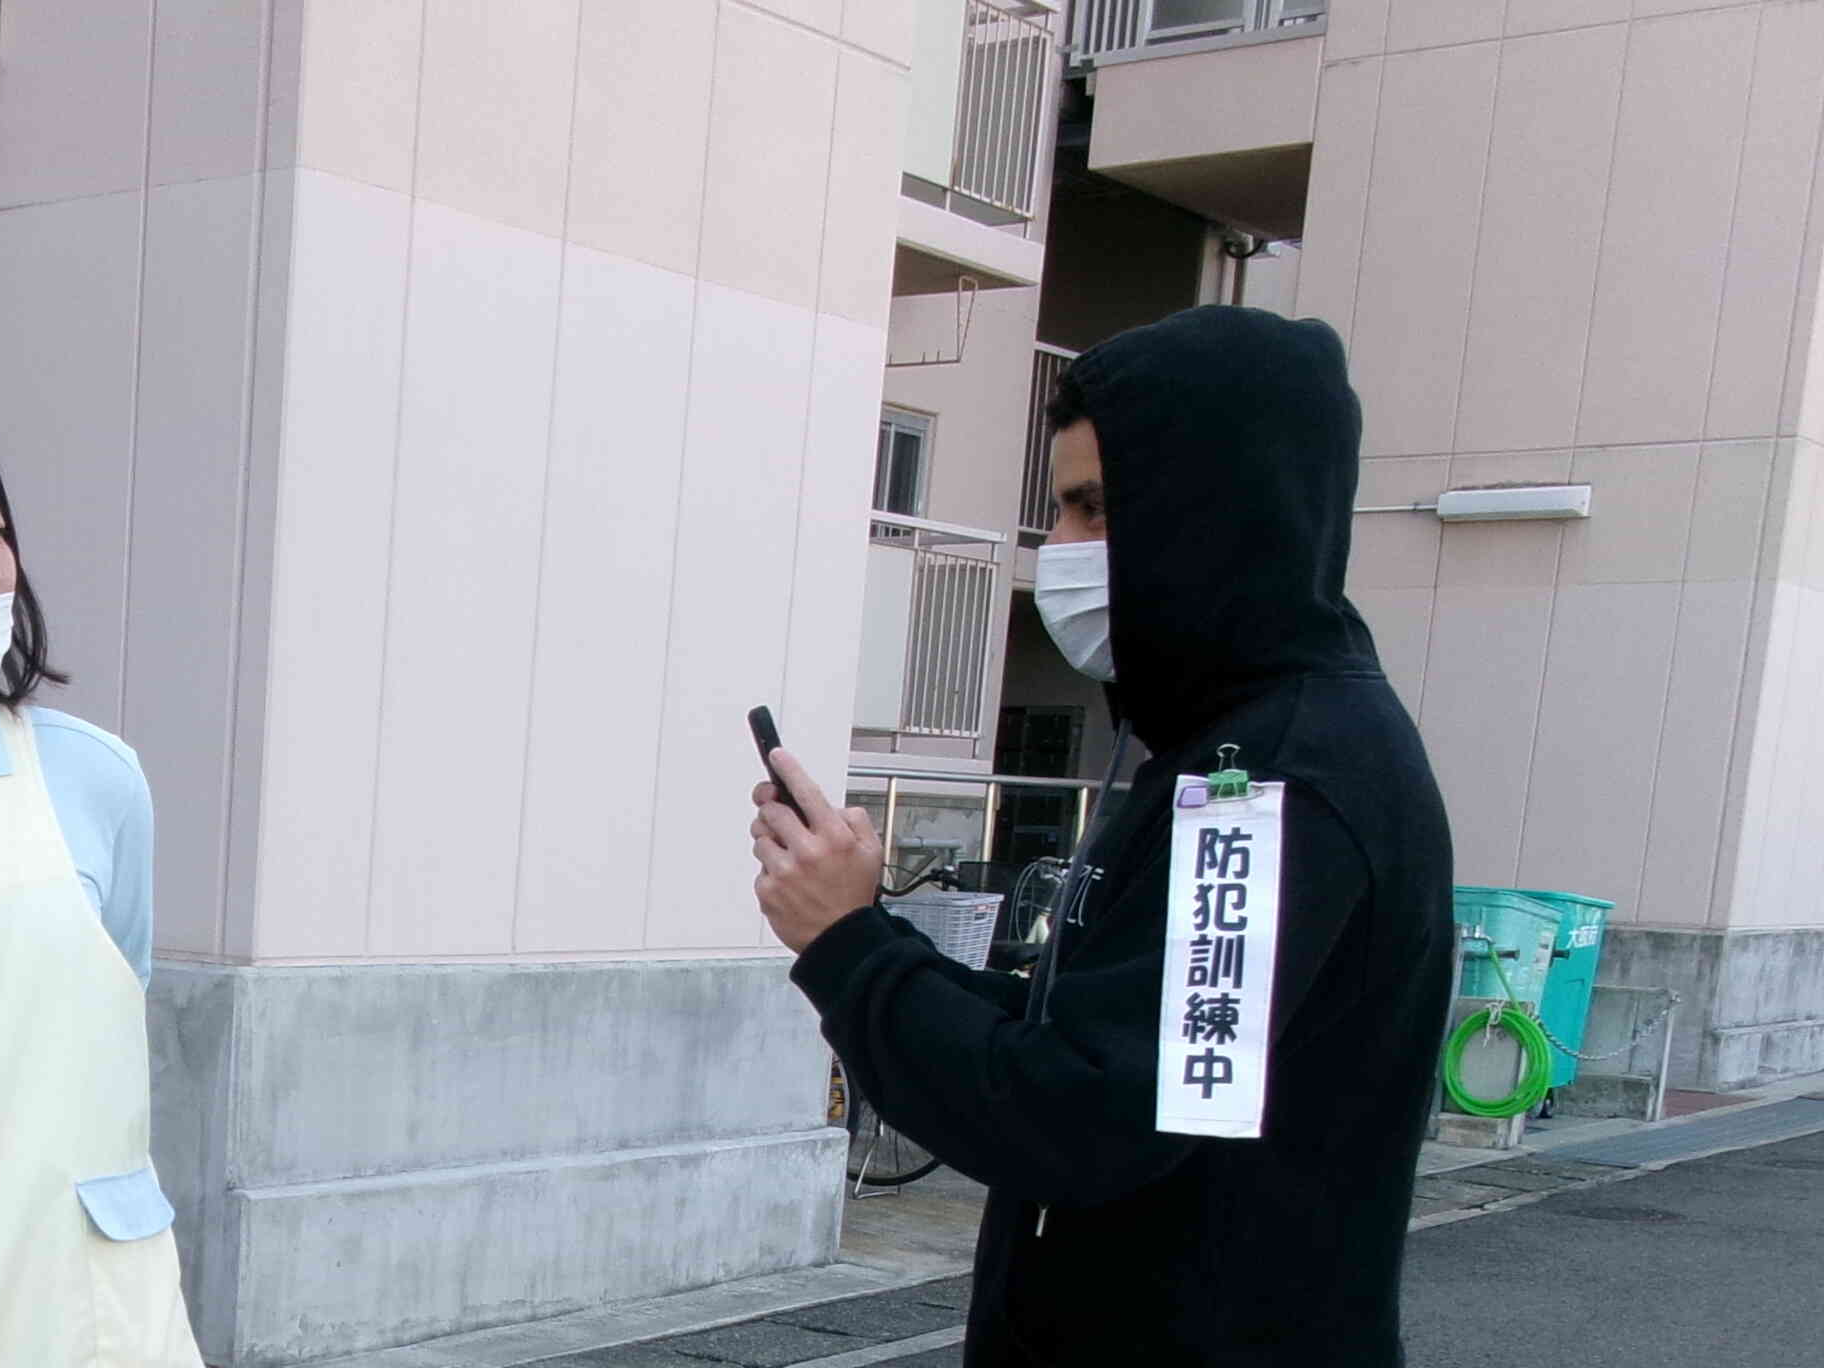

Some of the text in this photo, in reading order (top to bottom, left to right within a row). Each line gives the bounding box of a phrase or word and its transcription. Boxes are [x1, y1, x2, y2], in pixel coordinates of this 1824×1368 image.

[1182, 826, 1253, 1100] 防犯訓練中
